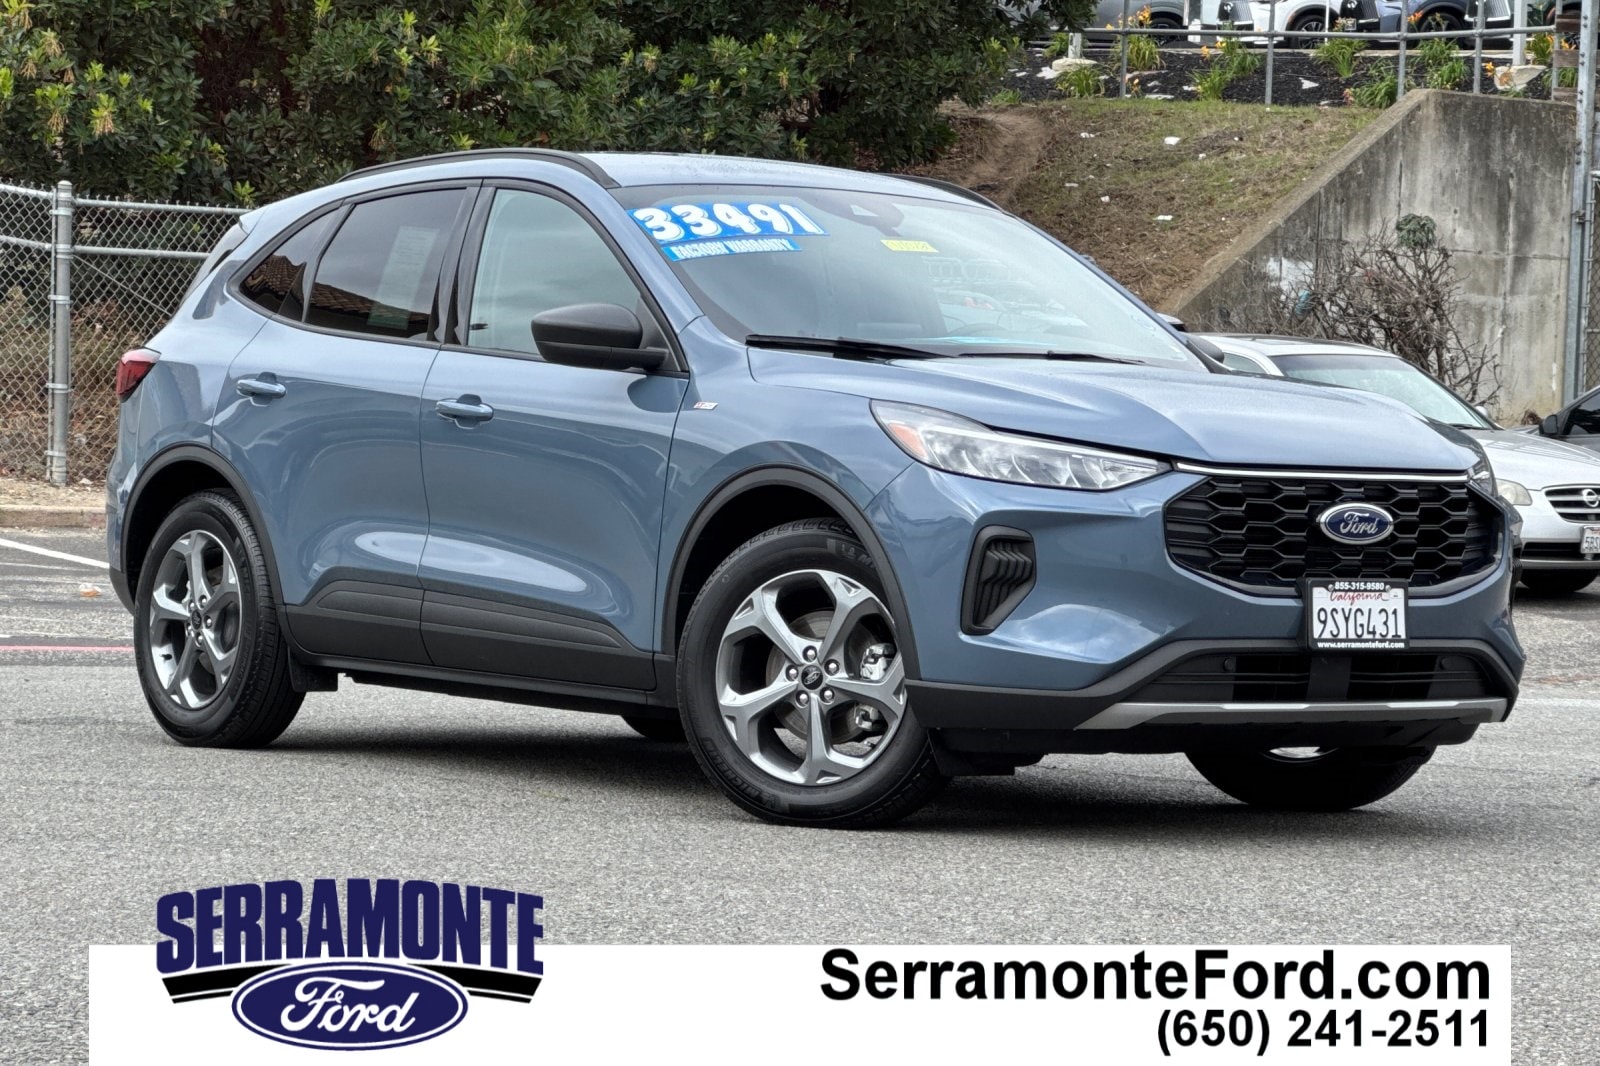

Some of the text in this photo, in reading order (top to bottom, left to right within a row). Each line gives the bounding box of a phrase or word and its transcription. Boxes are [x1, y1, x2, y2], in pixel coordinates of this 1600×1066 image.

[632, 202, 825, 241] 33491
[670, 238, 795, 260] FACTORY WARRANTY
[1340, 511, 1379, 534] Ford
[1334, 581, 1385, 591] 855-315-9580
[1329, 590, 1389, 606] California
[1317, 607, 1402, 639] 9SYG431
[1317, 640, 1405, 649] www.serramonteford.com
